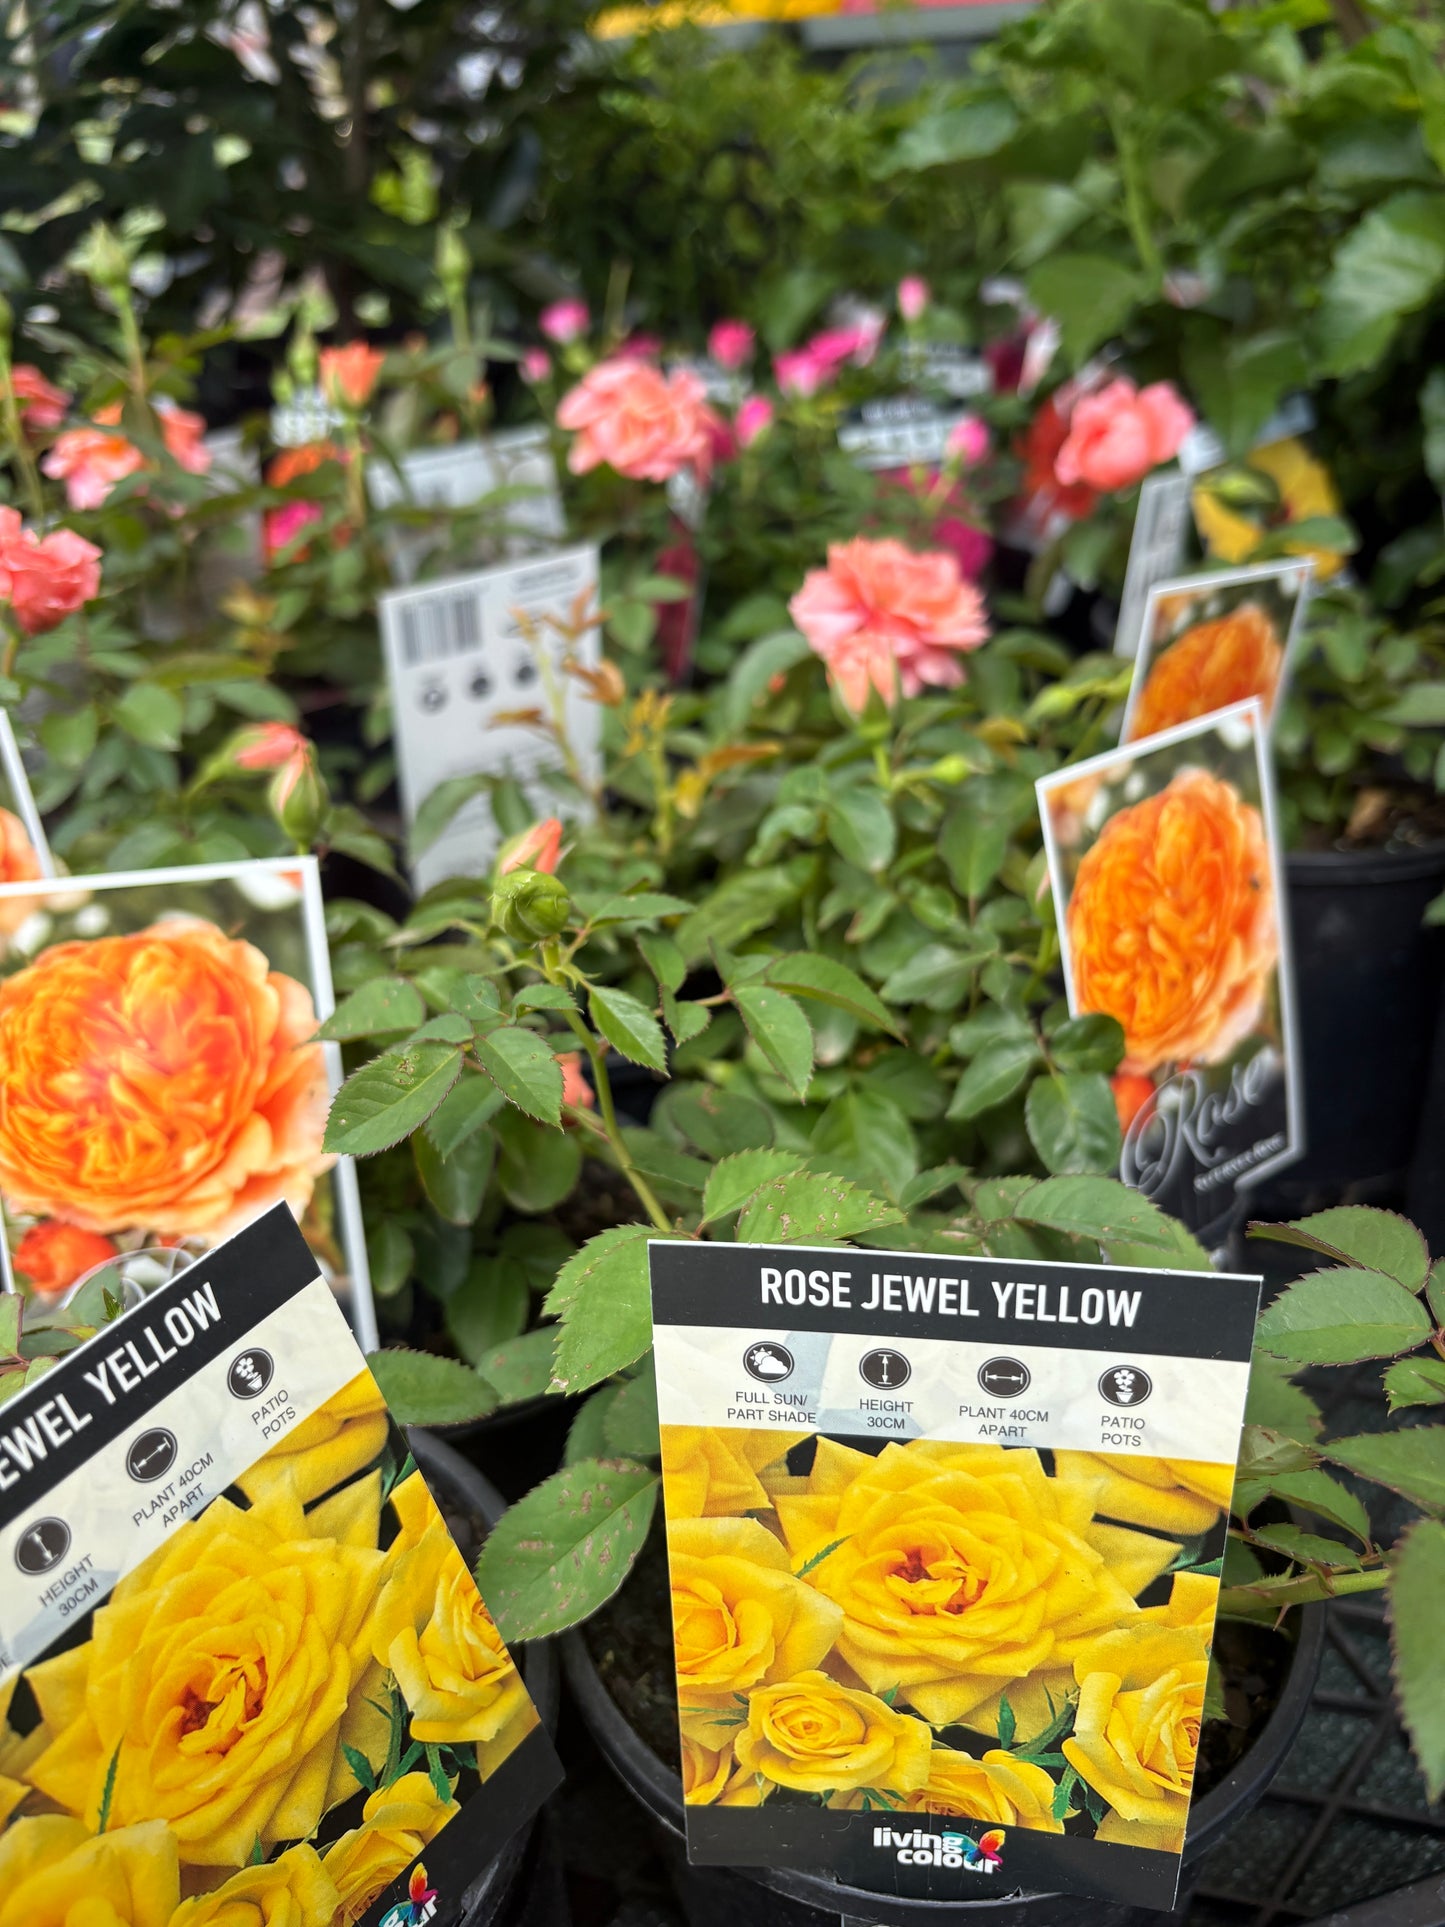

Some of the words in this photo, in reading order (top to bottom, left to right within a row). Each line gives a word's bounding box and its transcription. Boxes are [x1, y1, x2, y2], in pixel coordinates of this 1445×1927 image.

[760, 1267, 852, 1308] ROSE
[861, 1275, 980, 1318] JEWEL
[991, 1281, 1142, 1327] YELLOW
[0, 1393, 94, 1491] EWEL
[83, 1281, 222, 1405] YELLOW
[735, 1391, 770, 1405] FULL
[774, 1393, 808, 1406] SUN/
[251, 1389, 289, 1425] PATIO
[727, 1408, 765, 1421] PART
[768, 1410, 817, 1424] SHADE
[859, 1398, 914, 1414] HEIGHT
[959, 1405, 1006, 1419] PLANT
[1009, 1409, 1049, 1422] 40CM
[261, 1406, 296, 1440] POTS
[867, 1416, 905, 1429] 30CM
[978, 1424, 1027, 1437] APART
[1101, 1415, 1146, 1430] PATIO
[1101, 1432, 1142, 1447] POTS
[132, 1482, 177, 1527] PLANT
[179, 1452, 214, 1488] 40CM
[161, 1482, 206, 1528] APART
[39, 1553, 95, 1607] HEIGHT
[58, 1577, 99, 1617] 30CM
[873, 1827, 964, 1854] living
[897, 1849, 999, 1874] colour
